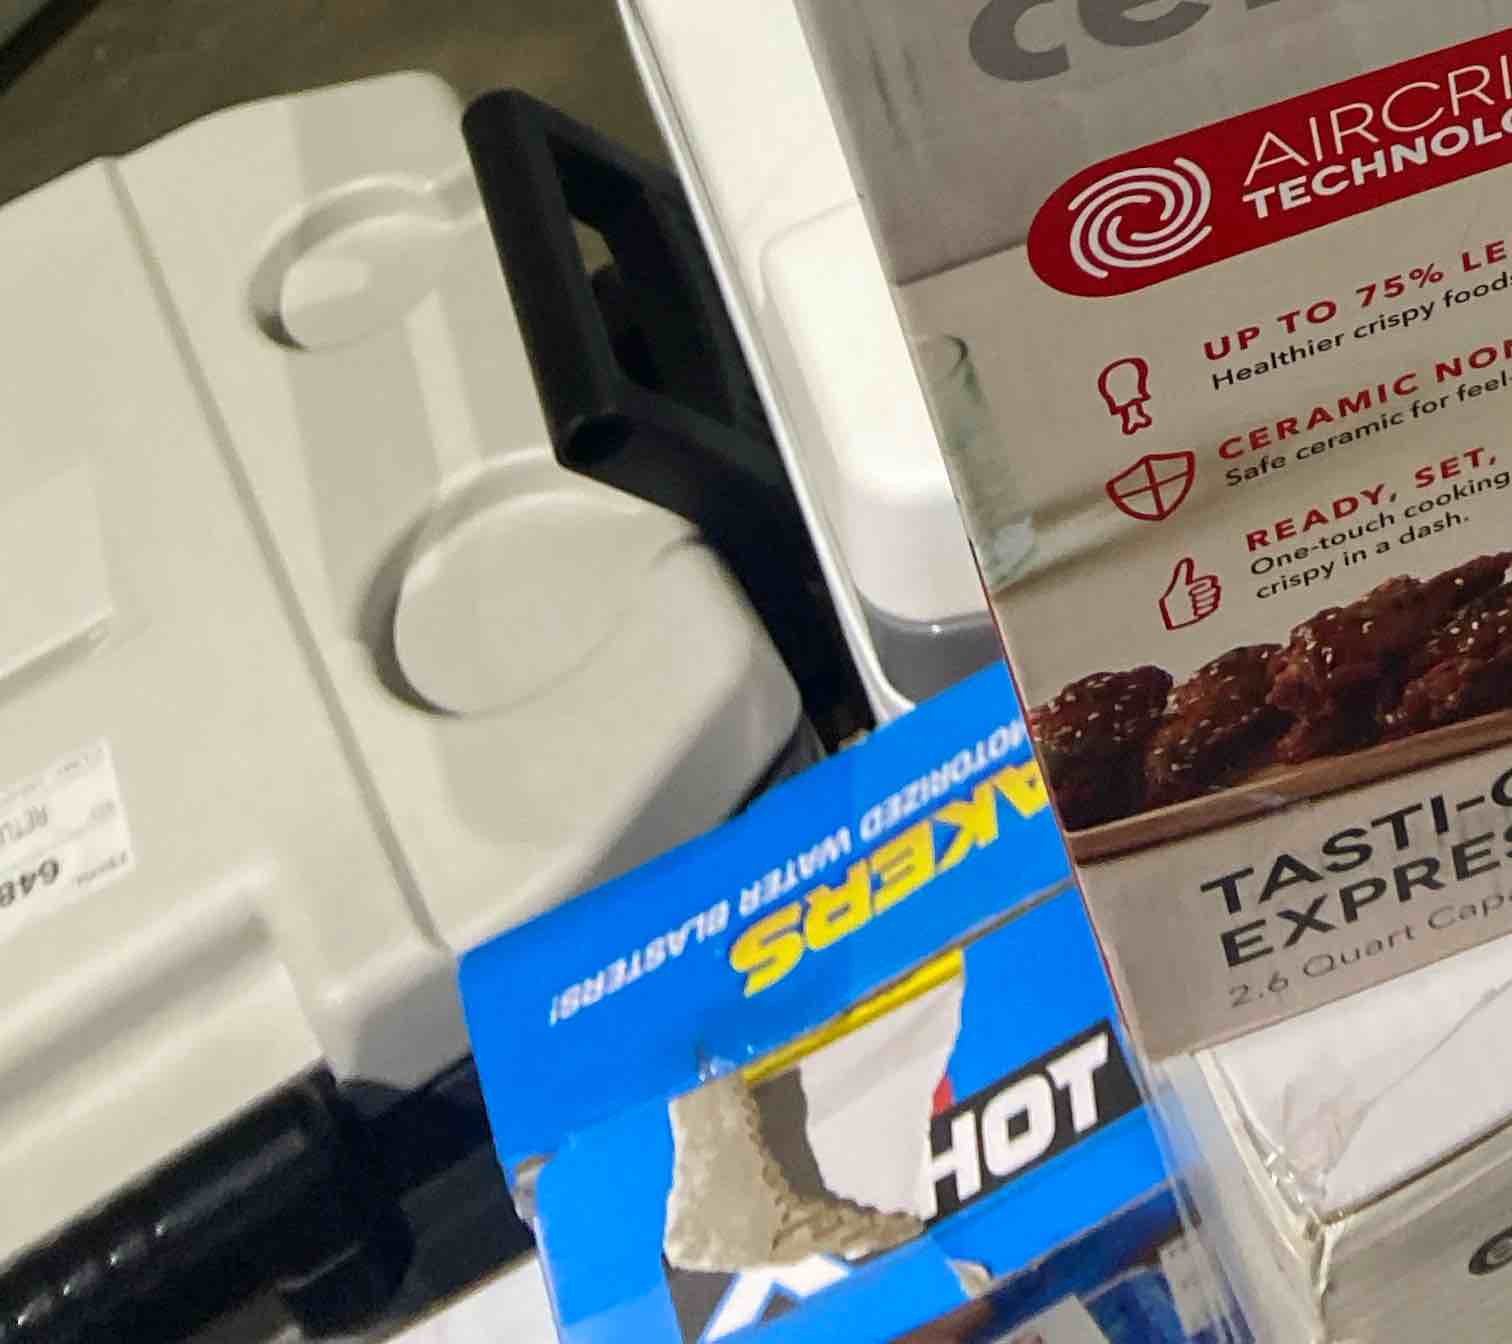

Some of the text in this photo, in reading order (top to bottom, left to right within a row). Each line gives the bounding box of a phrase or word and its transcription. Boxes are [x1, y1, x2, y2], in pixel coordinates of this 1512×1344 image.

[1204, 326, 1260, 360] UP
[1277, 301, 1337, 334] TO
[1356, 263, 1444, 307] 75%
[1212, 333, 1345, 390] Healthier
[1353, 300, 1436, 340] crispy
[1218, 373, 1419, 459] CERAMIC
[1226, 455, 1287, 486] Safe
[1296, 411, 1404, 460] ceramic
[1411, 395, 1449, 418] for
[1246, 483, 1397, 552] READY,
[1415, 447, 1496, 489] SET,
[1250, 512, 1395, 575] One-touch
[1404, 469, 1510, 519] cooking
[1256, 513, 1470, 600] crispy in a dash.
[738, 825, 852, 918] WATER
[549, 899, 731, 1027] BLASTERS!
[1228, 971, 1289, 1008] 2.6
[1303, 925, 1416, 978] Quart
